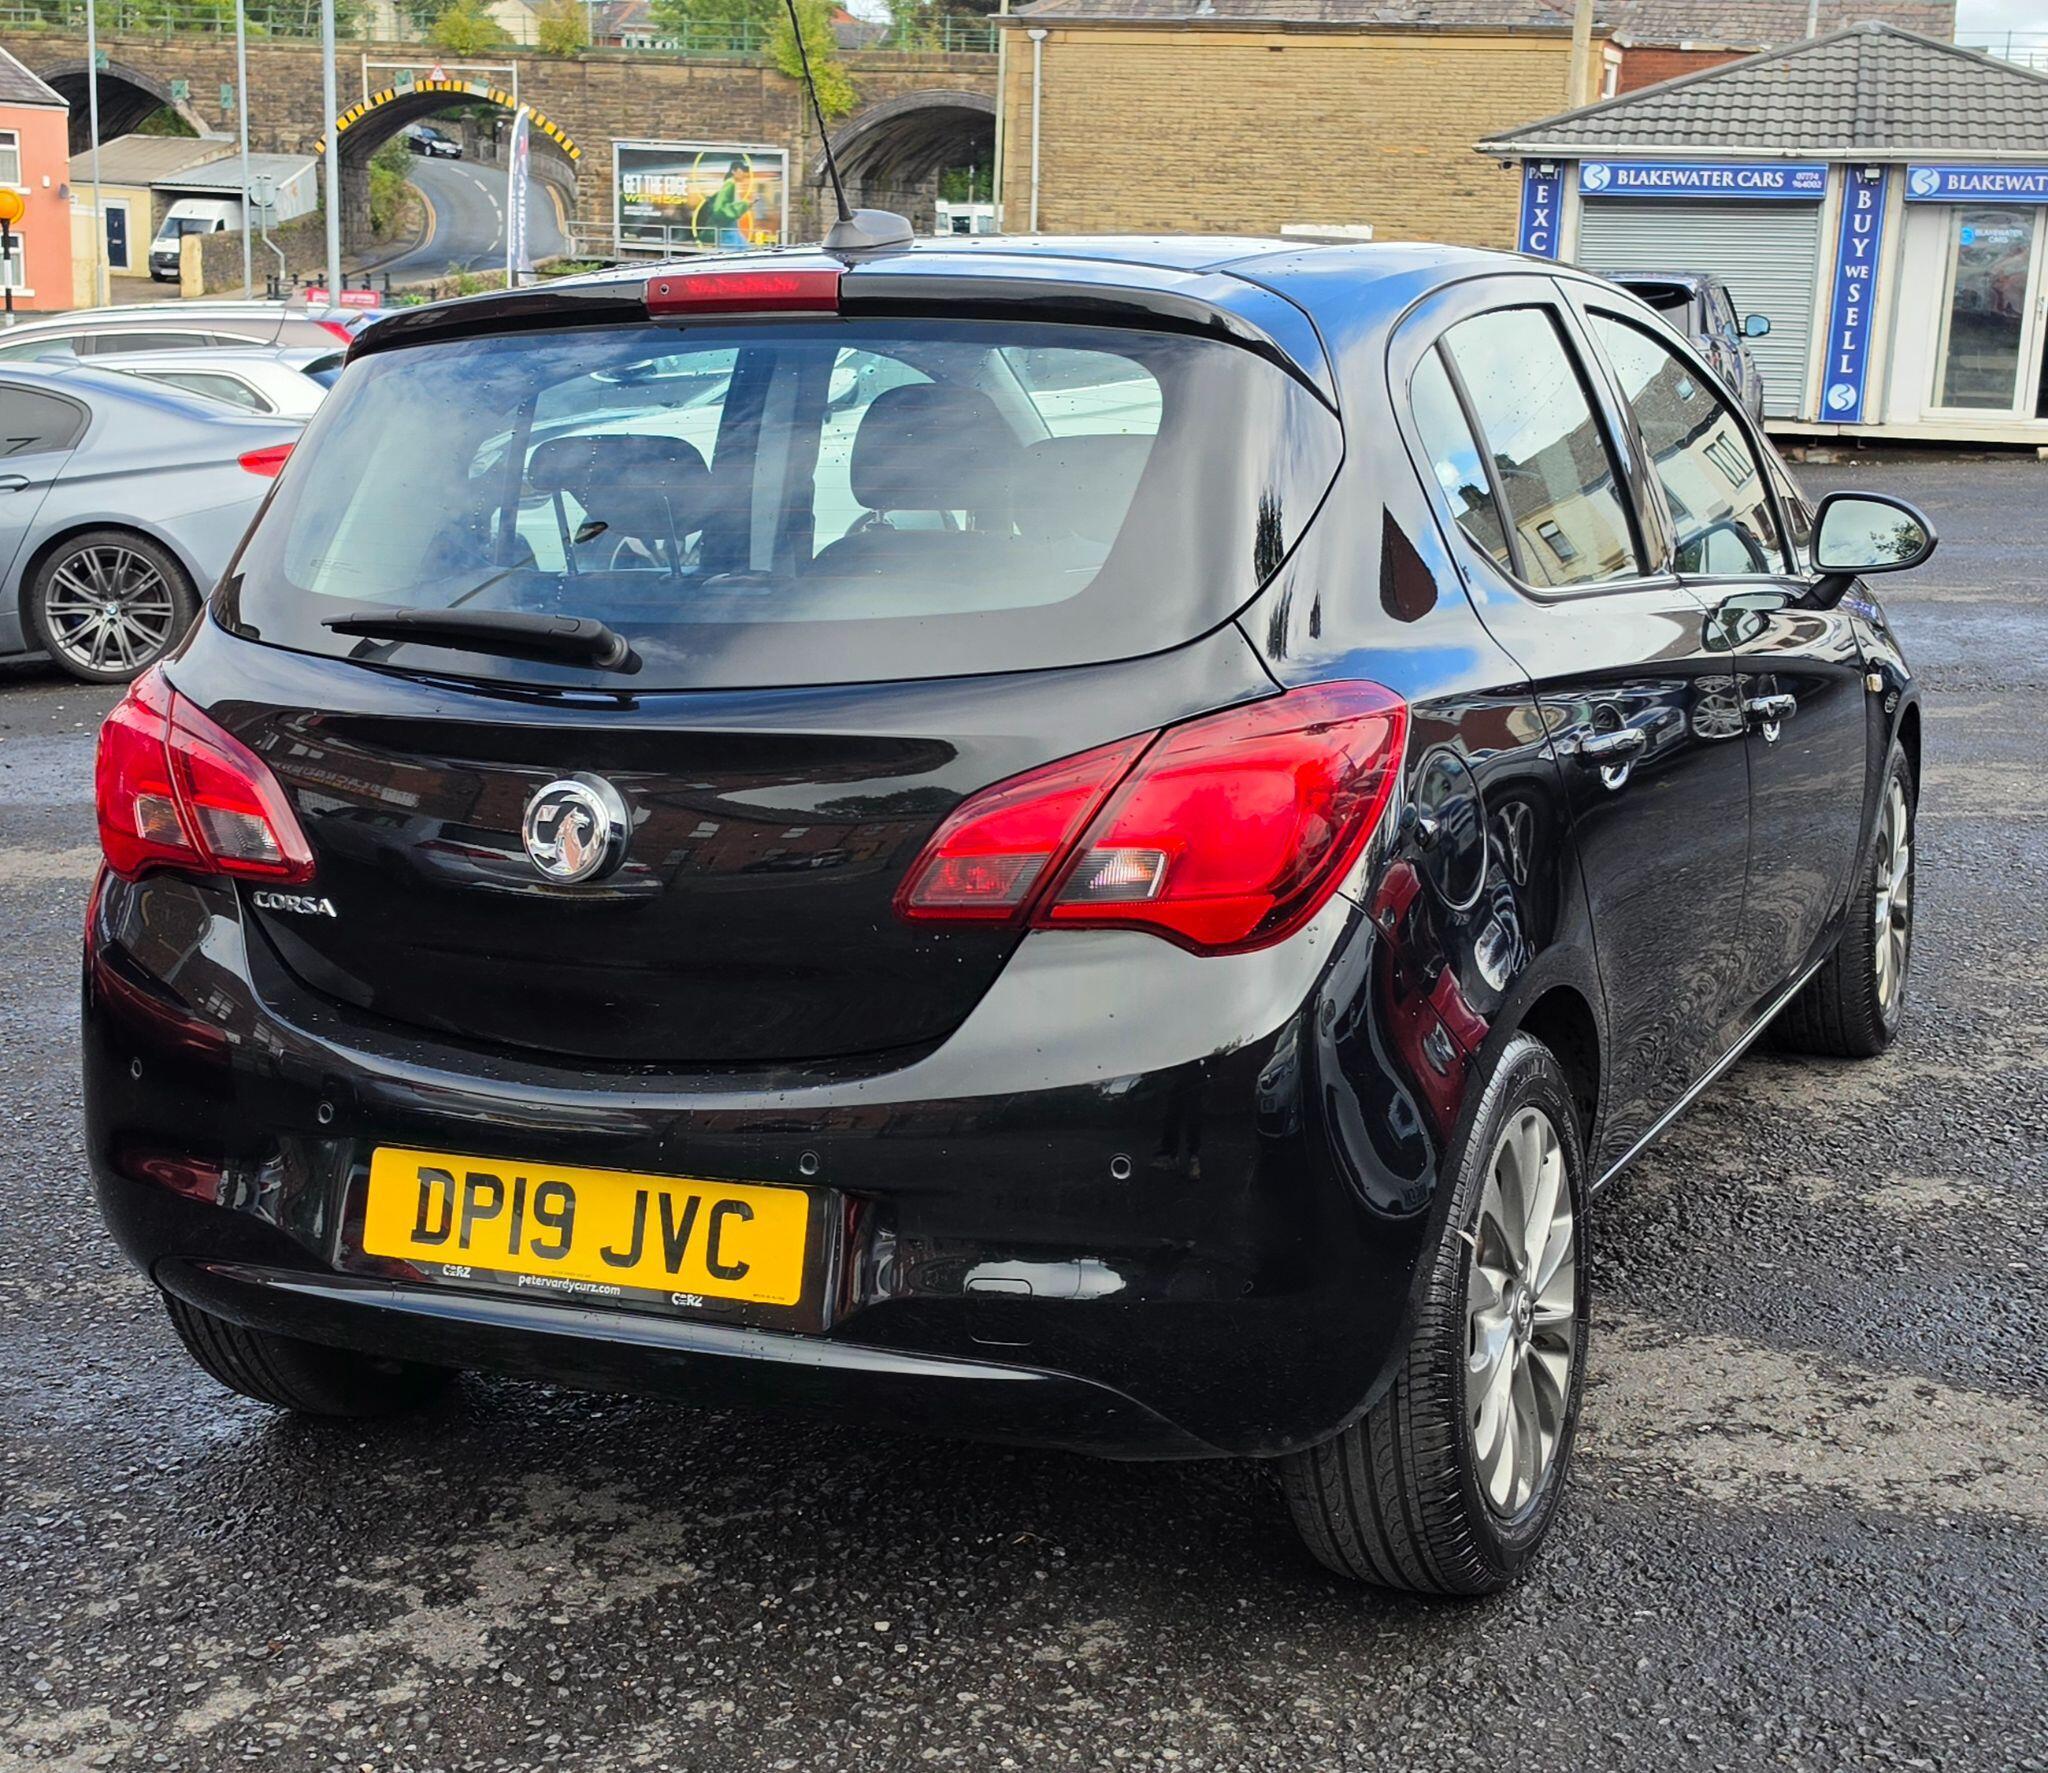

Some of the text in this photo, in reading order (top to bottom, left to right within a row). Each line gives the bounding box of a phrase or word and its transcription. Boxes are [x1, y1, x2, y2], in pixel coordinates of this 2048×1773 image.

[623, 174, 689, 196] GET THE EDGE
[1617, 169, 1785, 188] BLAKEWATER CARS
[1852, 190, 1872, 257] BUY
[1845, 265, 1869, 279] WE
[1839, 283, 1861, 374] SELL
[253, 891, 337, 918] CORSA
[410, 1166, 755, 1281] DP19 JVC
